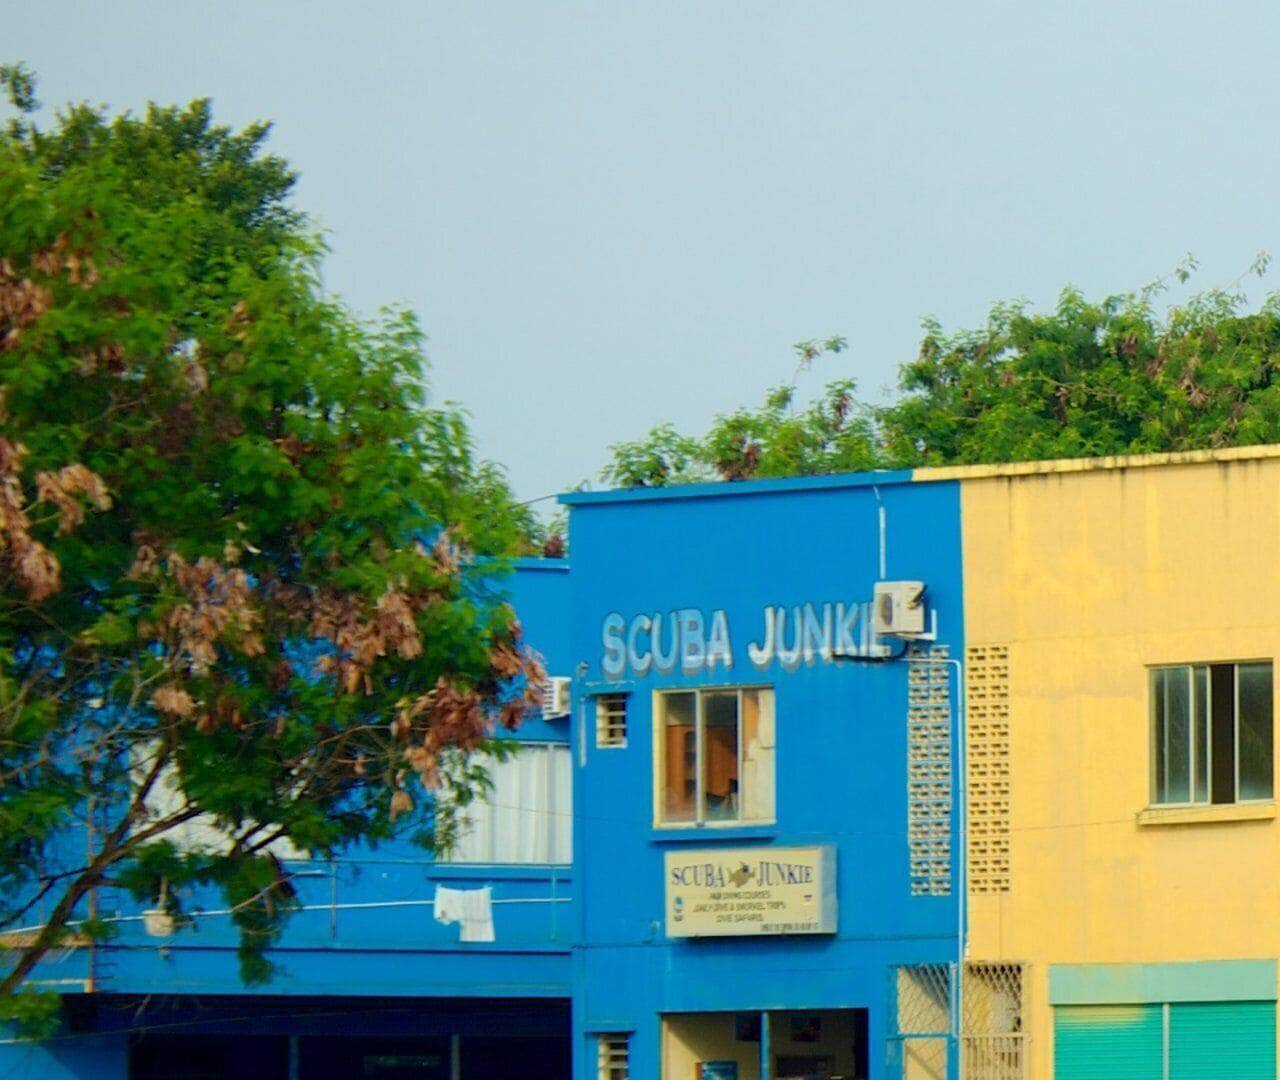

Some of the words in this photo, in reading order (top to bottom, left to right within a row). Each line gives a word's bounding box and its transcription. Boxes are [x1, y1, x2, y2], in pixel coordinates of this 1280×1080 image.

[602, 608, 733, 676] SCUBA
[672, 864, 726, 888] SCUBA
[757, 861, 813, 887] JUNKIE
